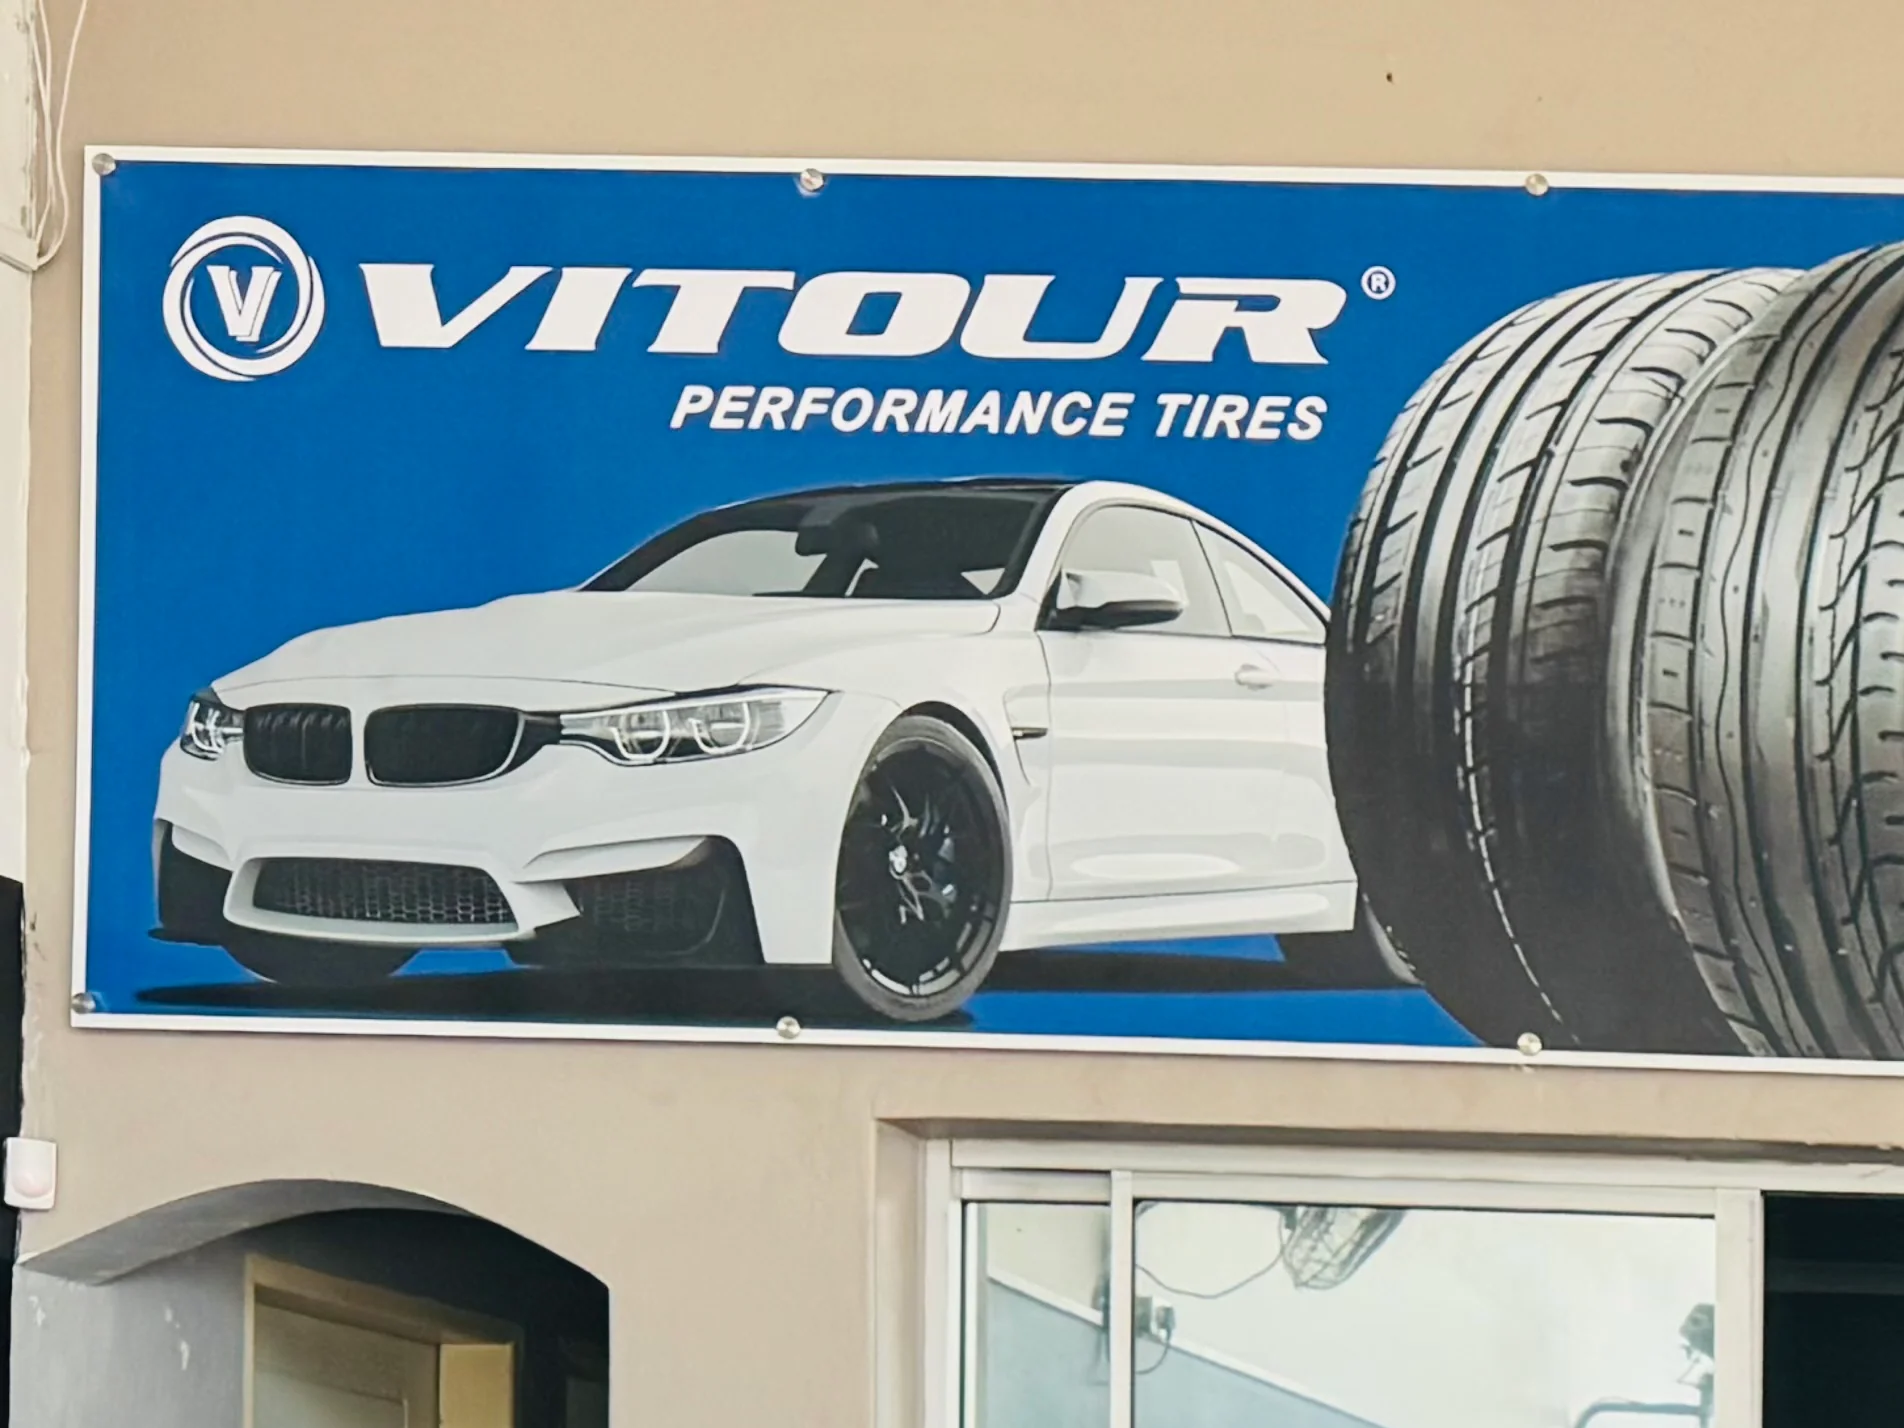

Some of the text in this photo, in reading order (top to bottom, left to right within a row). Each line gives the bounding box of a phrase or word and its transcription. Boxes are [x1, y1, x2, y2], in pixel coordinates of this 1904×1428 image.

[358, 262, 1348, 364] VITOUR
[670, 384, 1328, 442] PERFORMANCE TIRES
